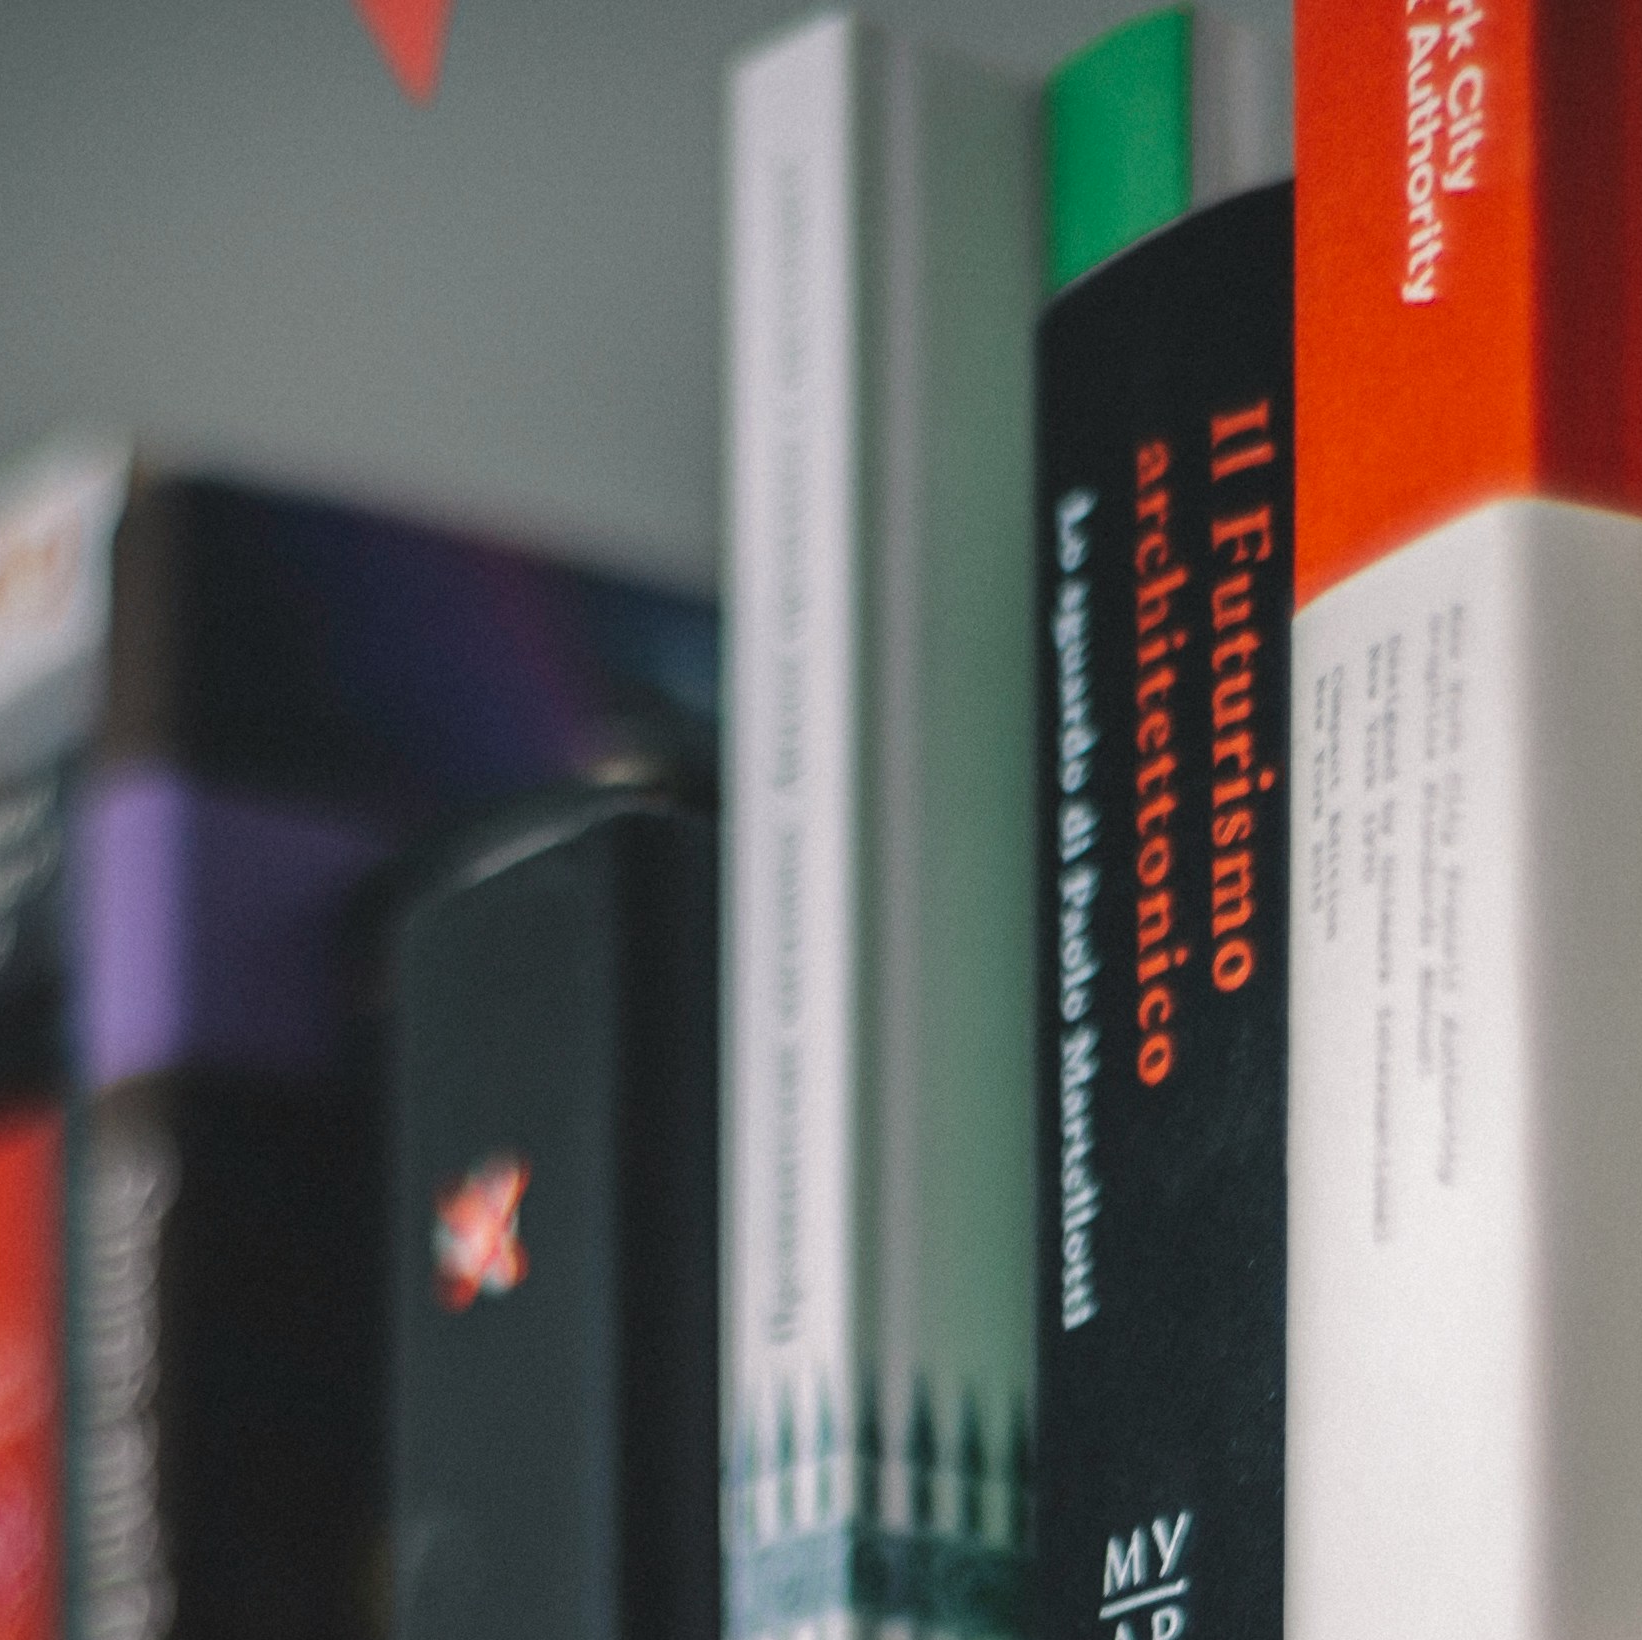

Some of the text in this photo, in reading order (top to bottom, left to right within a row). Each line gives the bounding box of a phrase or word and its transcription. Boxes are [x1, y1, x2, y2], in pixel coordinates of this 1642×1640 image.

[1402, 23, 1443, 304] Authority
[1442, 64, 1485, 192] City
[1051, 488, 1102, 1332] Lo sguardo di Paolo Martellotti
[1135, 438, 1190, 1088] architettonico
[1211, 398, 1275, 993] Il Futurismo
